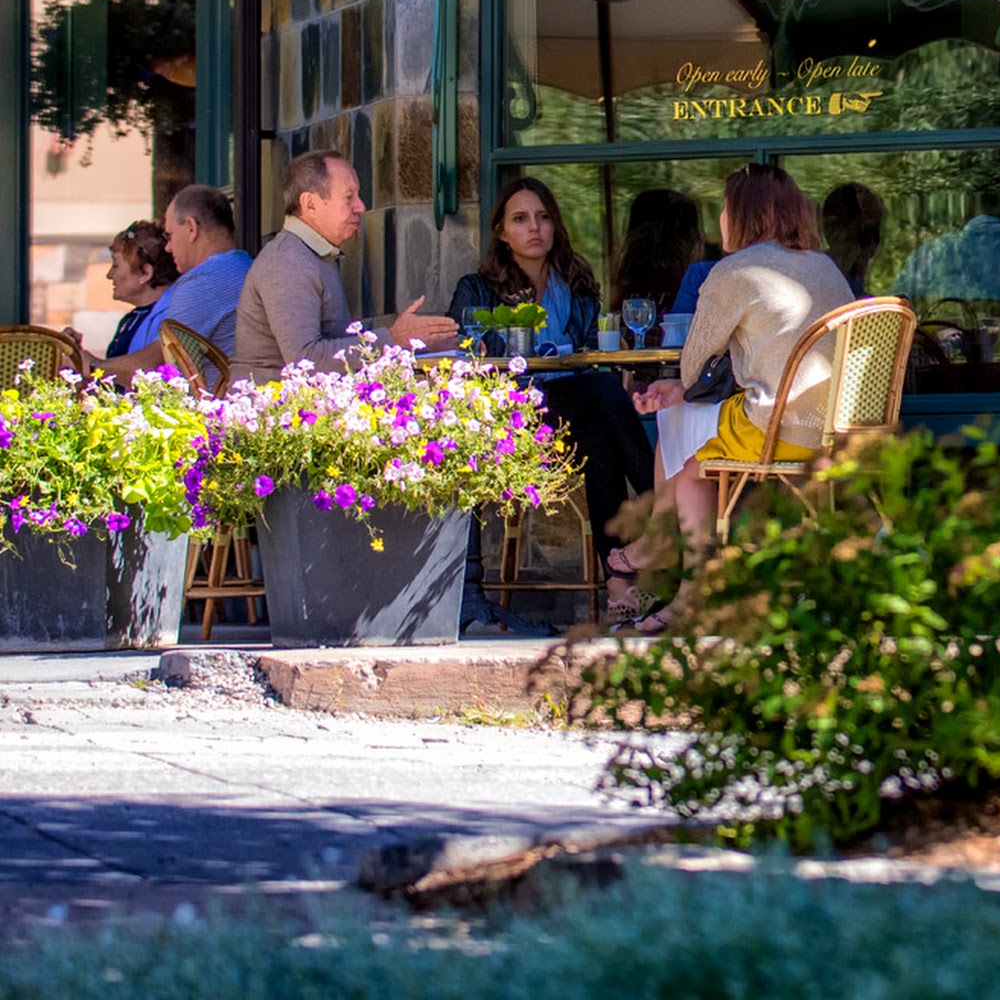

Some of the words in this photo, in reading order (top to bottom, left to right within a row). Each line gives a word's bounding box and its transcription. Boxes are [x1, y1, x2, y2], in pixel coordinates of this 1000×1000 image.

[676, 61, 723, 92] Open
[725, 59, 771, 89] early
[797, 57, 843, 88] Open
[847, 55, 882, 78] late
[673, 96, 821, 120] ENTRANCE
